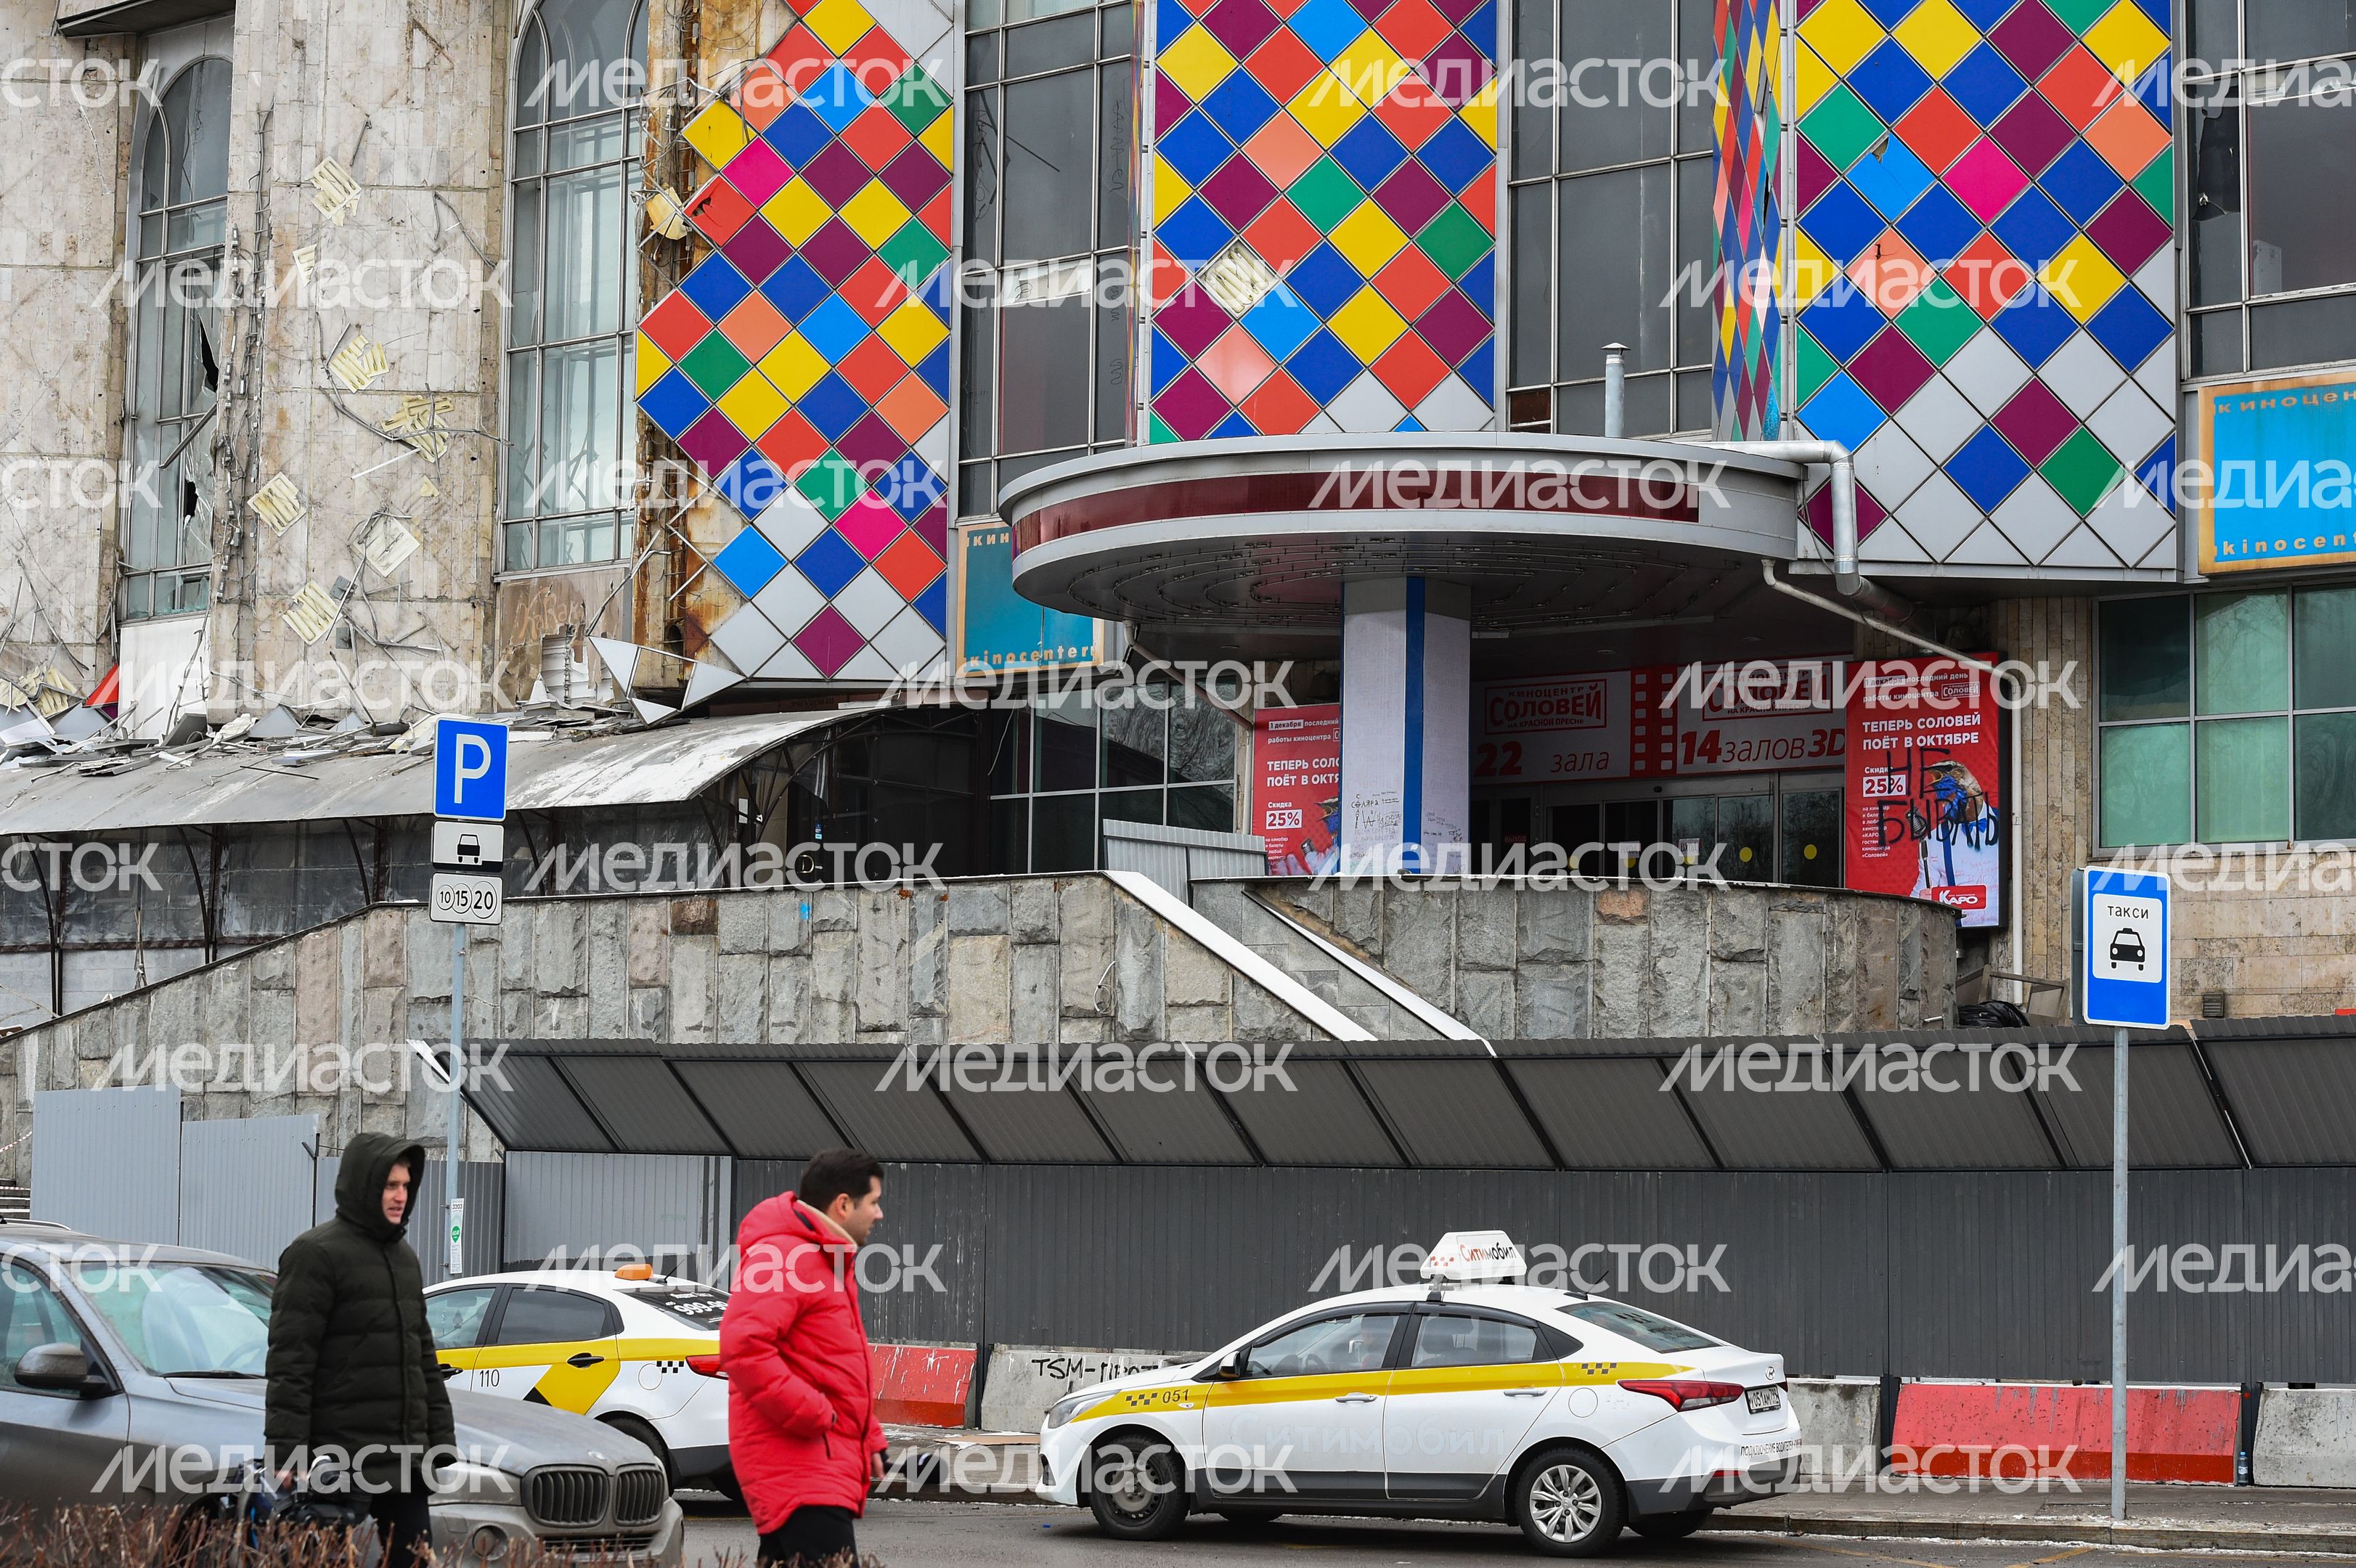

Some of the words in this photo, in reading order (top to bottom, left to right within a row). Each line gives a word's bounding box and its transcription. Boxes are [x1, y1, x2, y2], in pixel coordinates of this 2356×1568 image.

[1728, 670, 1809, 682] КИНОЦЕНТР
[1871, 677, 1903, 686] декабря
[1907, 672, 1948, 683] последний
[1949, 672, 1968, 681] день
[1509, 686, 1584, 698] КИНОЦЕНТР
[1863, 694, 1891, 703] работы
[1894, 690, 1939, 701] киноцентра
[1740, 701, 1777, 714] КРАСНОЙ
[1274, 722, 1302, 731] декабря
[1304, 718, 1339, 727] последний
[1862, 718, 1913, 733] ТЕПЕРЬ
[1917, 711, 1981, 730] СОЛОВЕЙ
[1293, 734, 1331, 743] киноцентра
[1863, 735, 1899, 750] ПОЁТ
[1904, 737, 1913, 748] В
[1917, 732, 1979, 747] ОКТЯБРЕ
[1681, 730, 1721, 765] 14
[1722, 738, 1806, 763] залов
[1808, 728, 1846, 757] 3D
[1267, 760, 1308, 771] ТЕПЕРЬ
[1474, 740, 1523, 777] 22
[1550, 751, 1610, 773] зала
[454, 733, 492, 804] P
[1864, 766, 1893, 775] Скидк
[1887, 747, 1951, 799] НЕ
[1267, 774, 1297, 787] ПОЁТ
[1301, 775, 1308, 785] В
[1864, 777, 1904, 795] 25%
[1268, 812, 1300, 827] 25%
[440, 891, 451, 900] 10
[455, 890, 468, 907] 15
[473, 890, 494, 910] 20
[2108, 904, 2150, 920] такси
[1460, 1242, 1517, 1262] Ситимобил
[479, 1369, 500, 1388] 110
[1162, 1389, 1189, 1404] 051
[1230, 1410, 1505, 1456] Ситимобил
